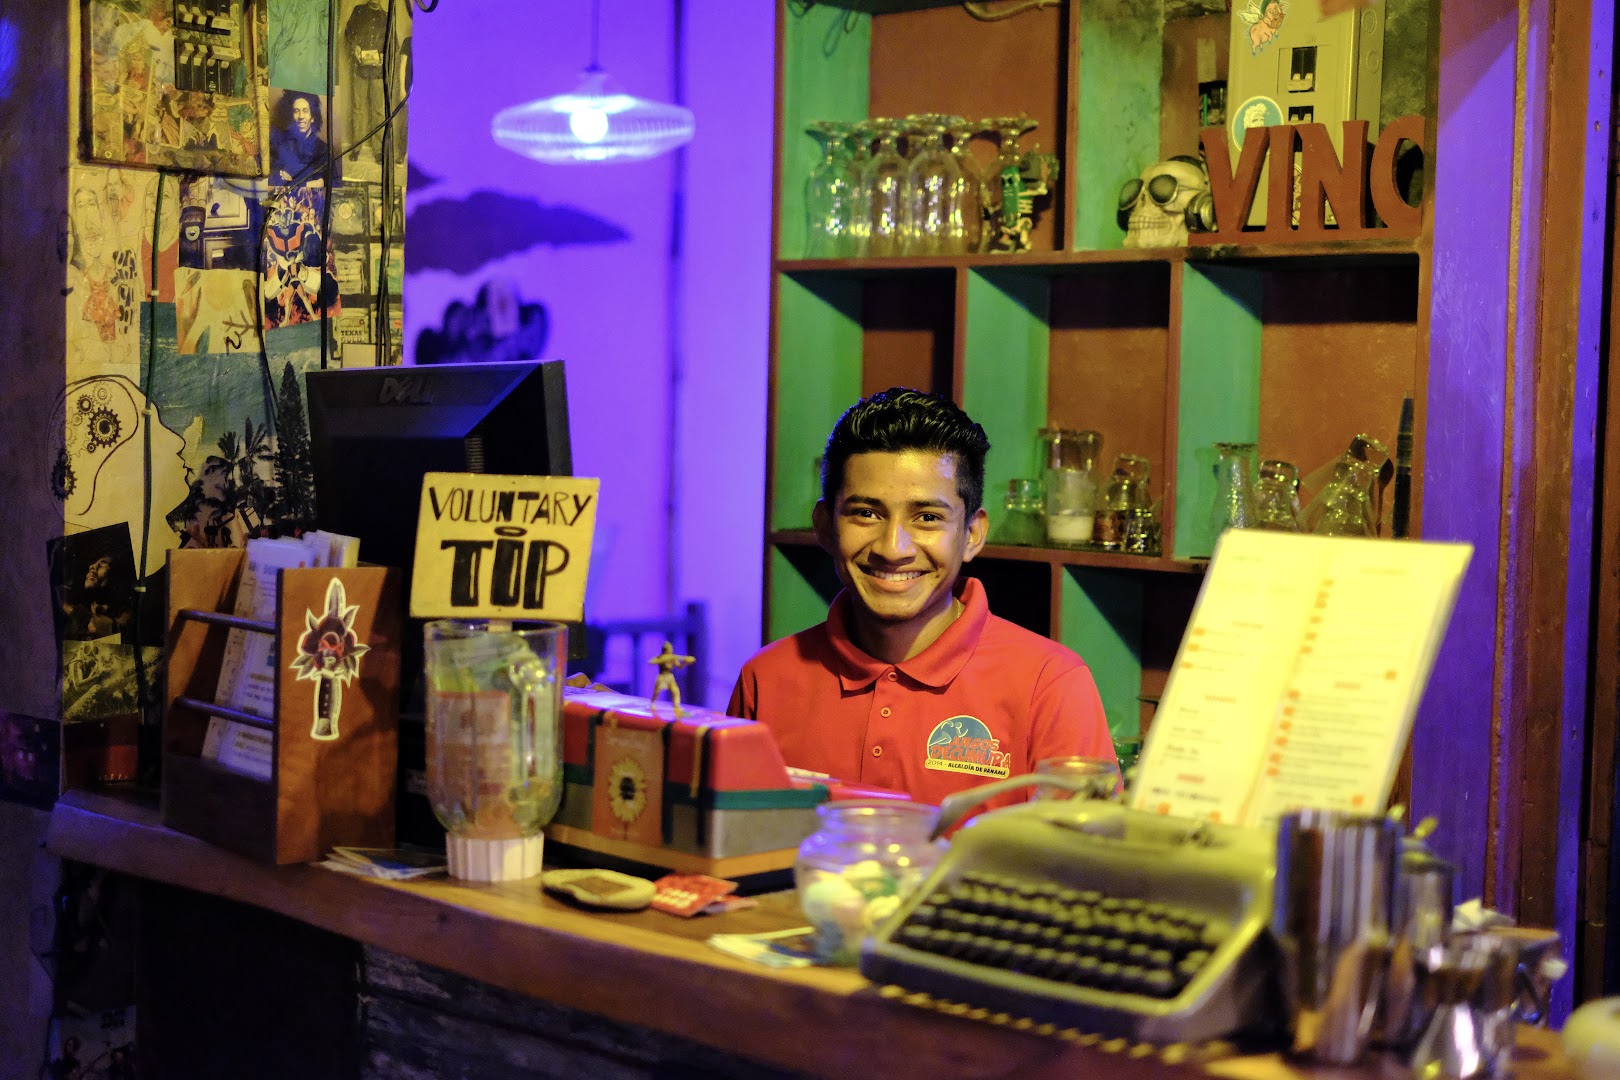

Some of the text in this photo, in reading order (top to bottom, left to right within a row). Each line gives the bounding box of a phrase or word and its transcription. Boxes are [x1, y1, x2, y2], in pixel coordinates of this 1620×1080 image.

[429, 486, 592, 527] VOLUNTARY
[440, 528, 570, 609] TIP
[950, 736, 1000, 751] JUEGOS
[948, 762, 974, 771] ALCALDÍA
[984, 767, 1006, 775] PANAMÁ
